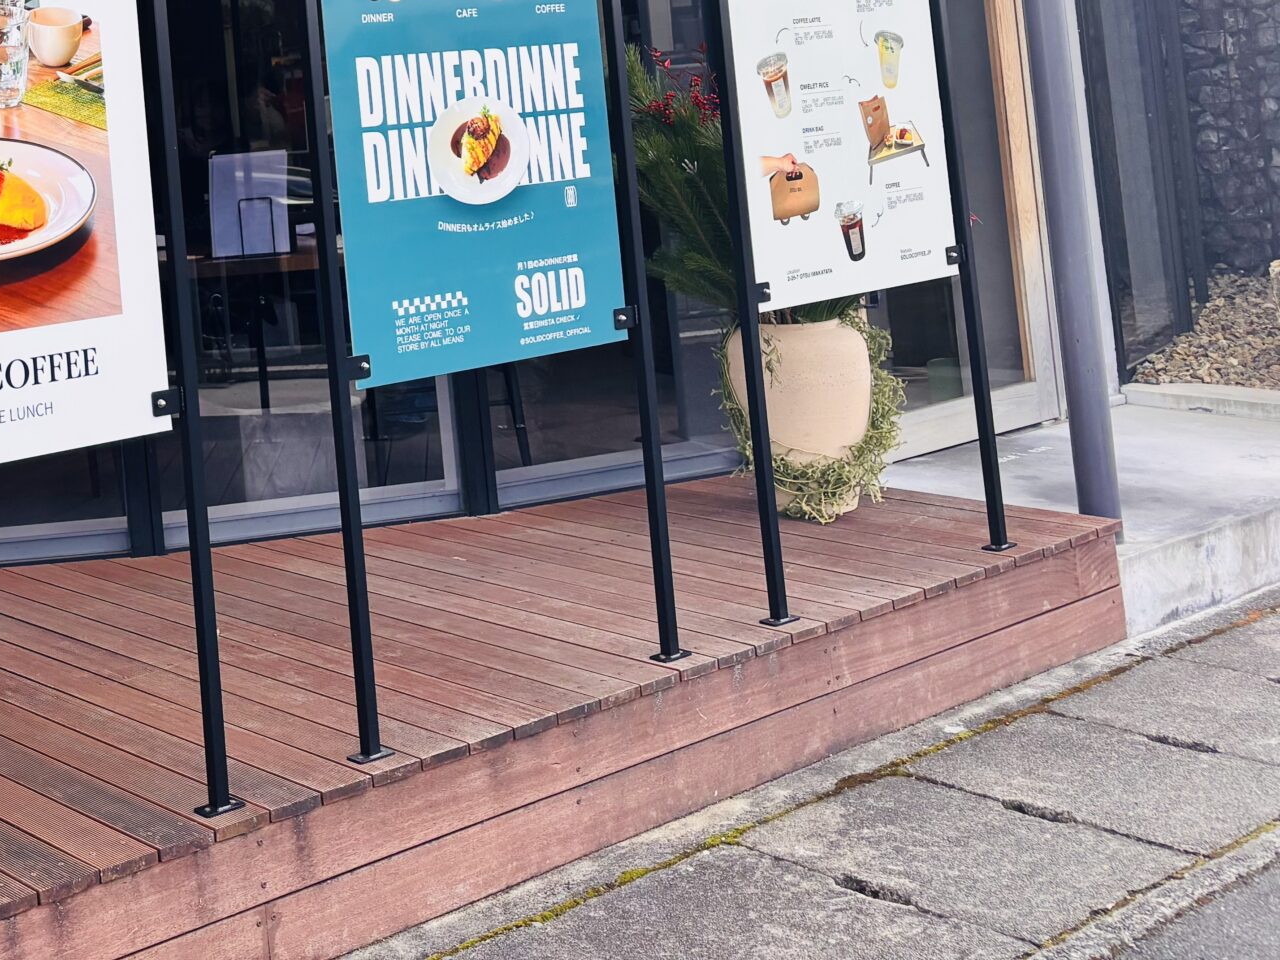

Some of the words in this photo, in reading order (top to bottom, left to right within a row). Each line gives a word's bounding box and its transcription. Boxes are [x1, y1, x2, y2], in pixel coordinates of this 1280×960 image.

[456, 7, 479, 19] CAFE
[535, 3, 566, 15] COFFEE
[361, 12, 395, 24] DINNER
[792, 17, 809, 25] COFFEE
[809, 16, 822, 24] LATTE
[800, 82, 818, 91] OMELET
[818, 81, 829, 89] RICE
[885, 181, 901, 190] COFFEE
[514, 266, 587, 319] SOLID
[395, 318, 406, 327] WE
[408, 315, 422, 324] ARE
[423, 312, 442, 322] OPEN
[444, 308, 462, 319] ONCE
[464, 308, 470, 316] A
[555, 314, 576, 325] CHECK
[395, 325, 419, 336] MONTH
[420, 323, 429, 332] AT
[429, 319, 449, 329] NIGHT
[396, 333, 422, 345] PLEASE
[423, 329, 443, 340] COME
[445, 327, 455, 336] TO
[456, 324, 471, 334] OUR
[519, 326, 592, 346] @SOLIDCOFFEE_OFFICIAL
[397, 342, 420, 354] STORE
[420, 341, 429, 350] BY
[430, 338, 442, 348] ALL
[442, 334, 465, 346] MEANS
[10, 401, 54, 423] LUNCH
